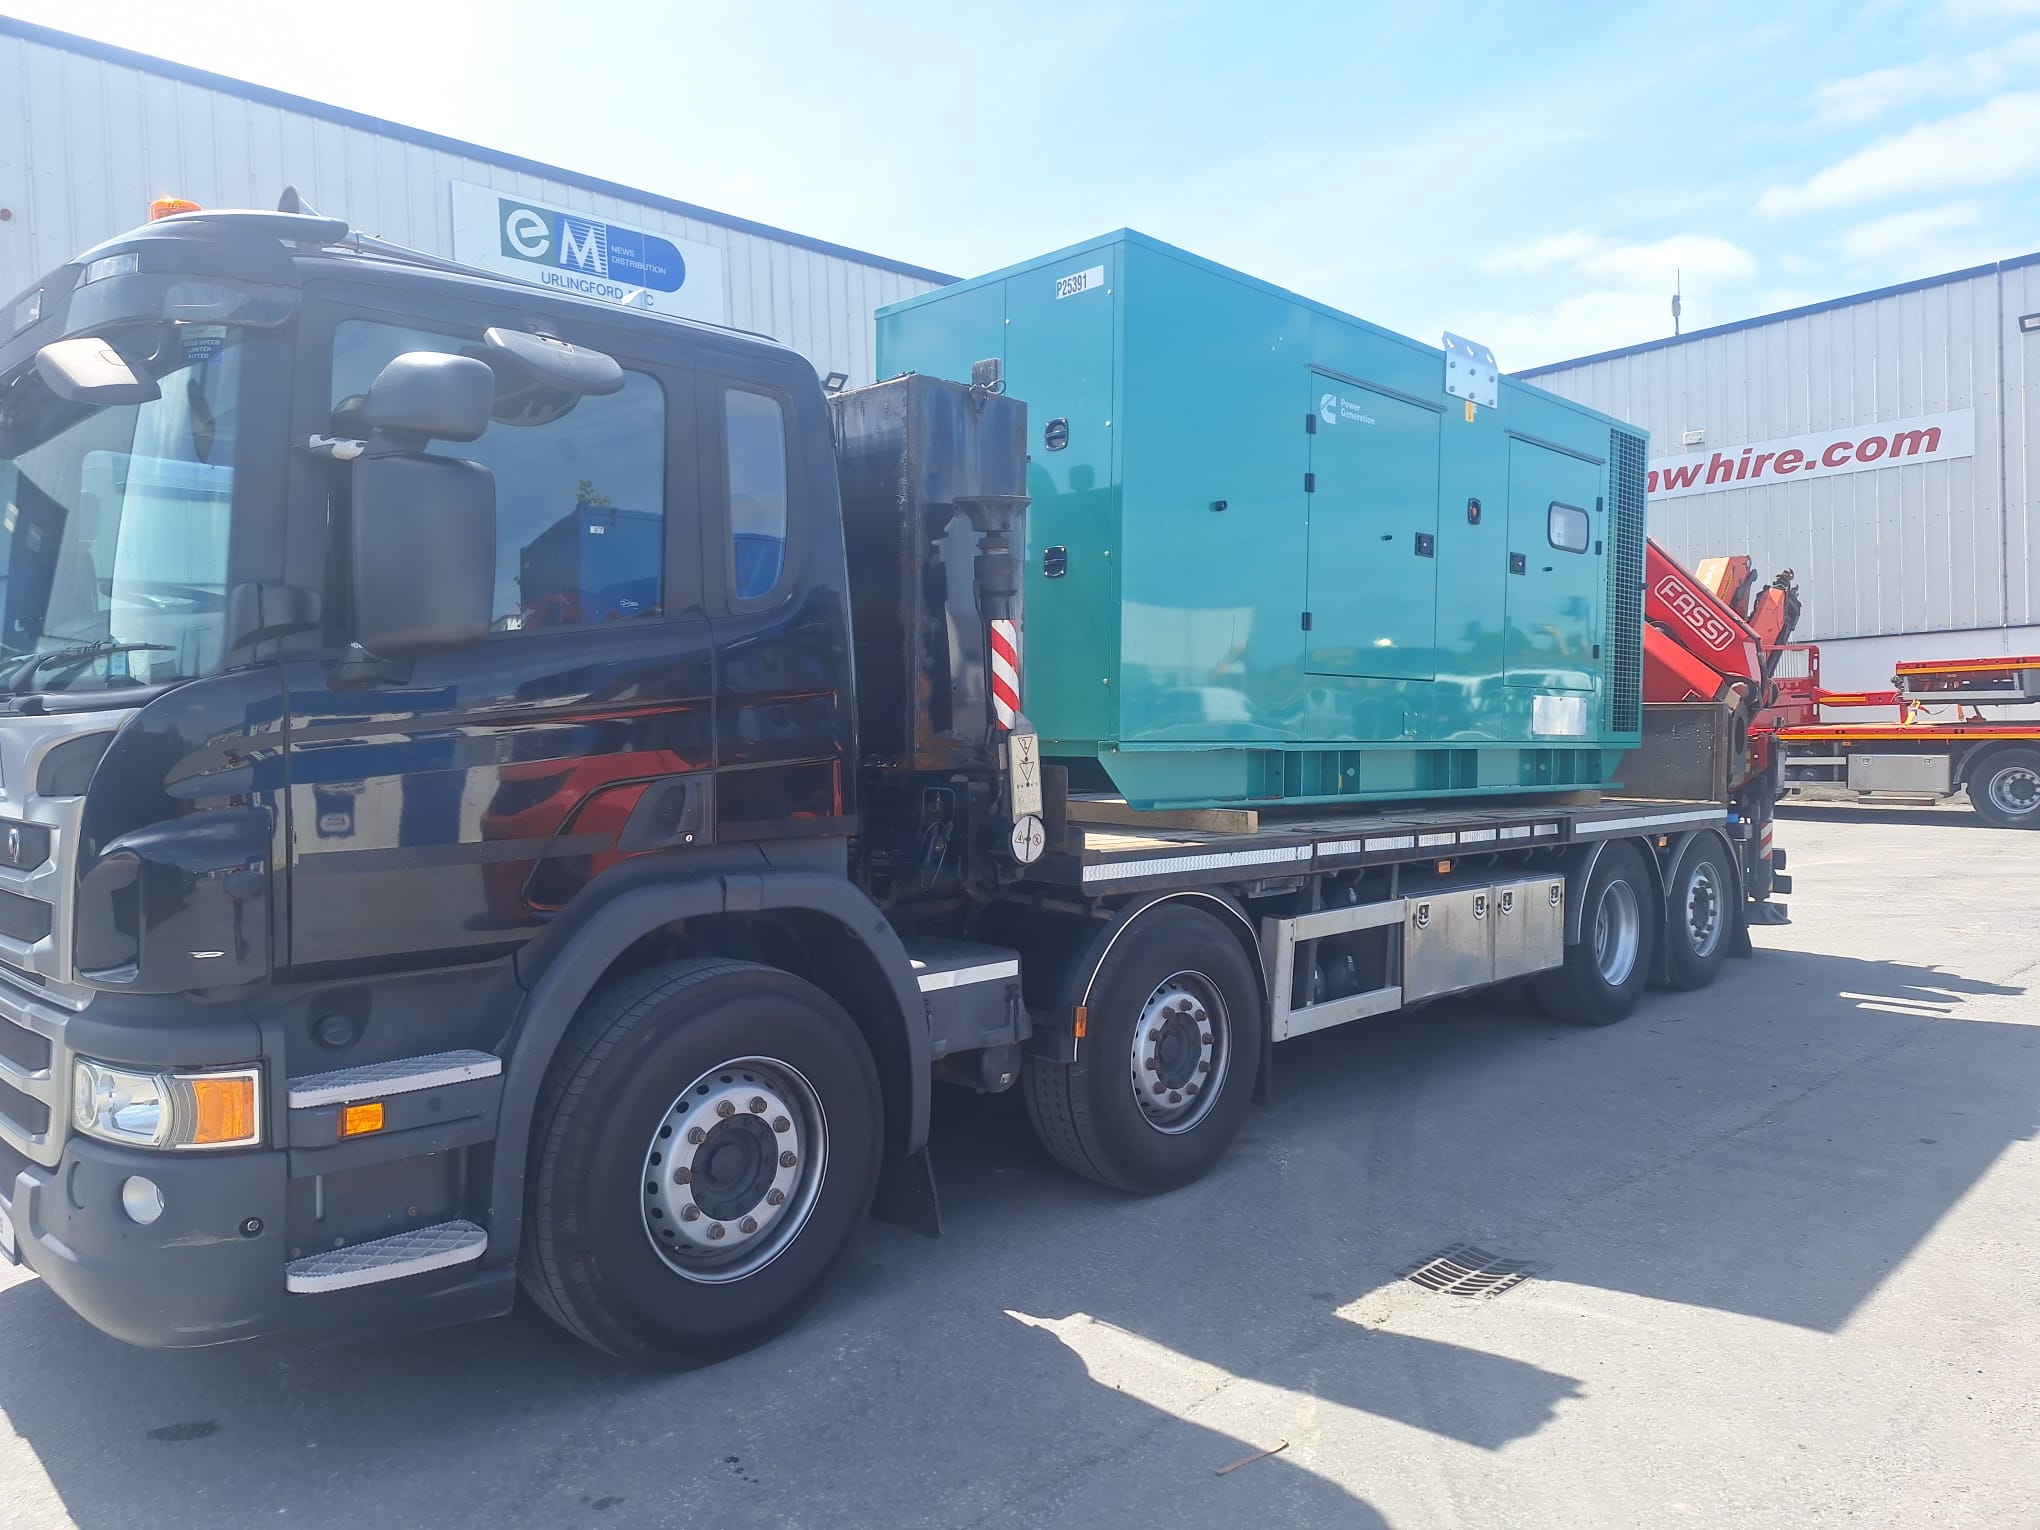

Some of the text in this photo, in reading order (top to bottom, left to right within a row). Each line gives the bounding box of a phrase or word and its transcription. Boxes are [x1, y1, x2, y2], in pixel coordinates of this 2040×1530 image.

[611, 245, 635, 257] NEWS
[611, 256, 667, 275] DISTRIBUTION
[541, 271, 624, 300] URLINGFORD
[1056, 273, 1087, 298] P25391
[1340, 398, 1361, 412] Power
[1340, 407, 1375, 425] Generation
[1659, 581, 1729, 645] FASSI
